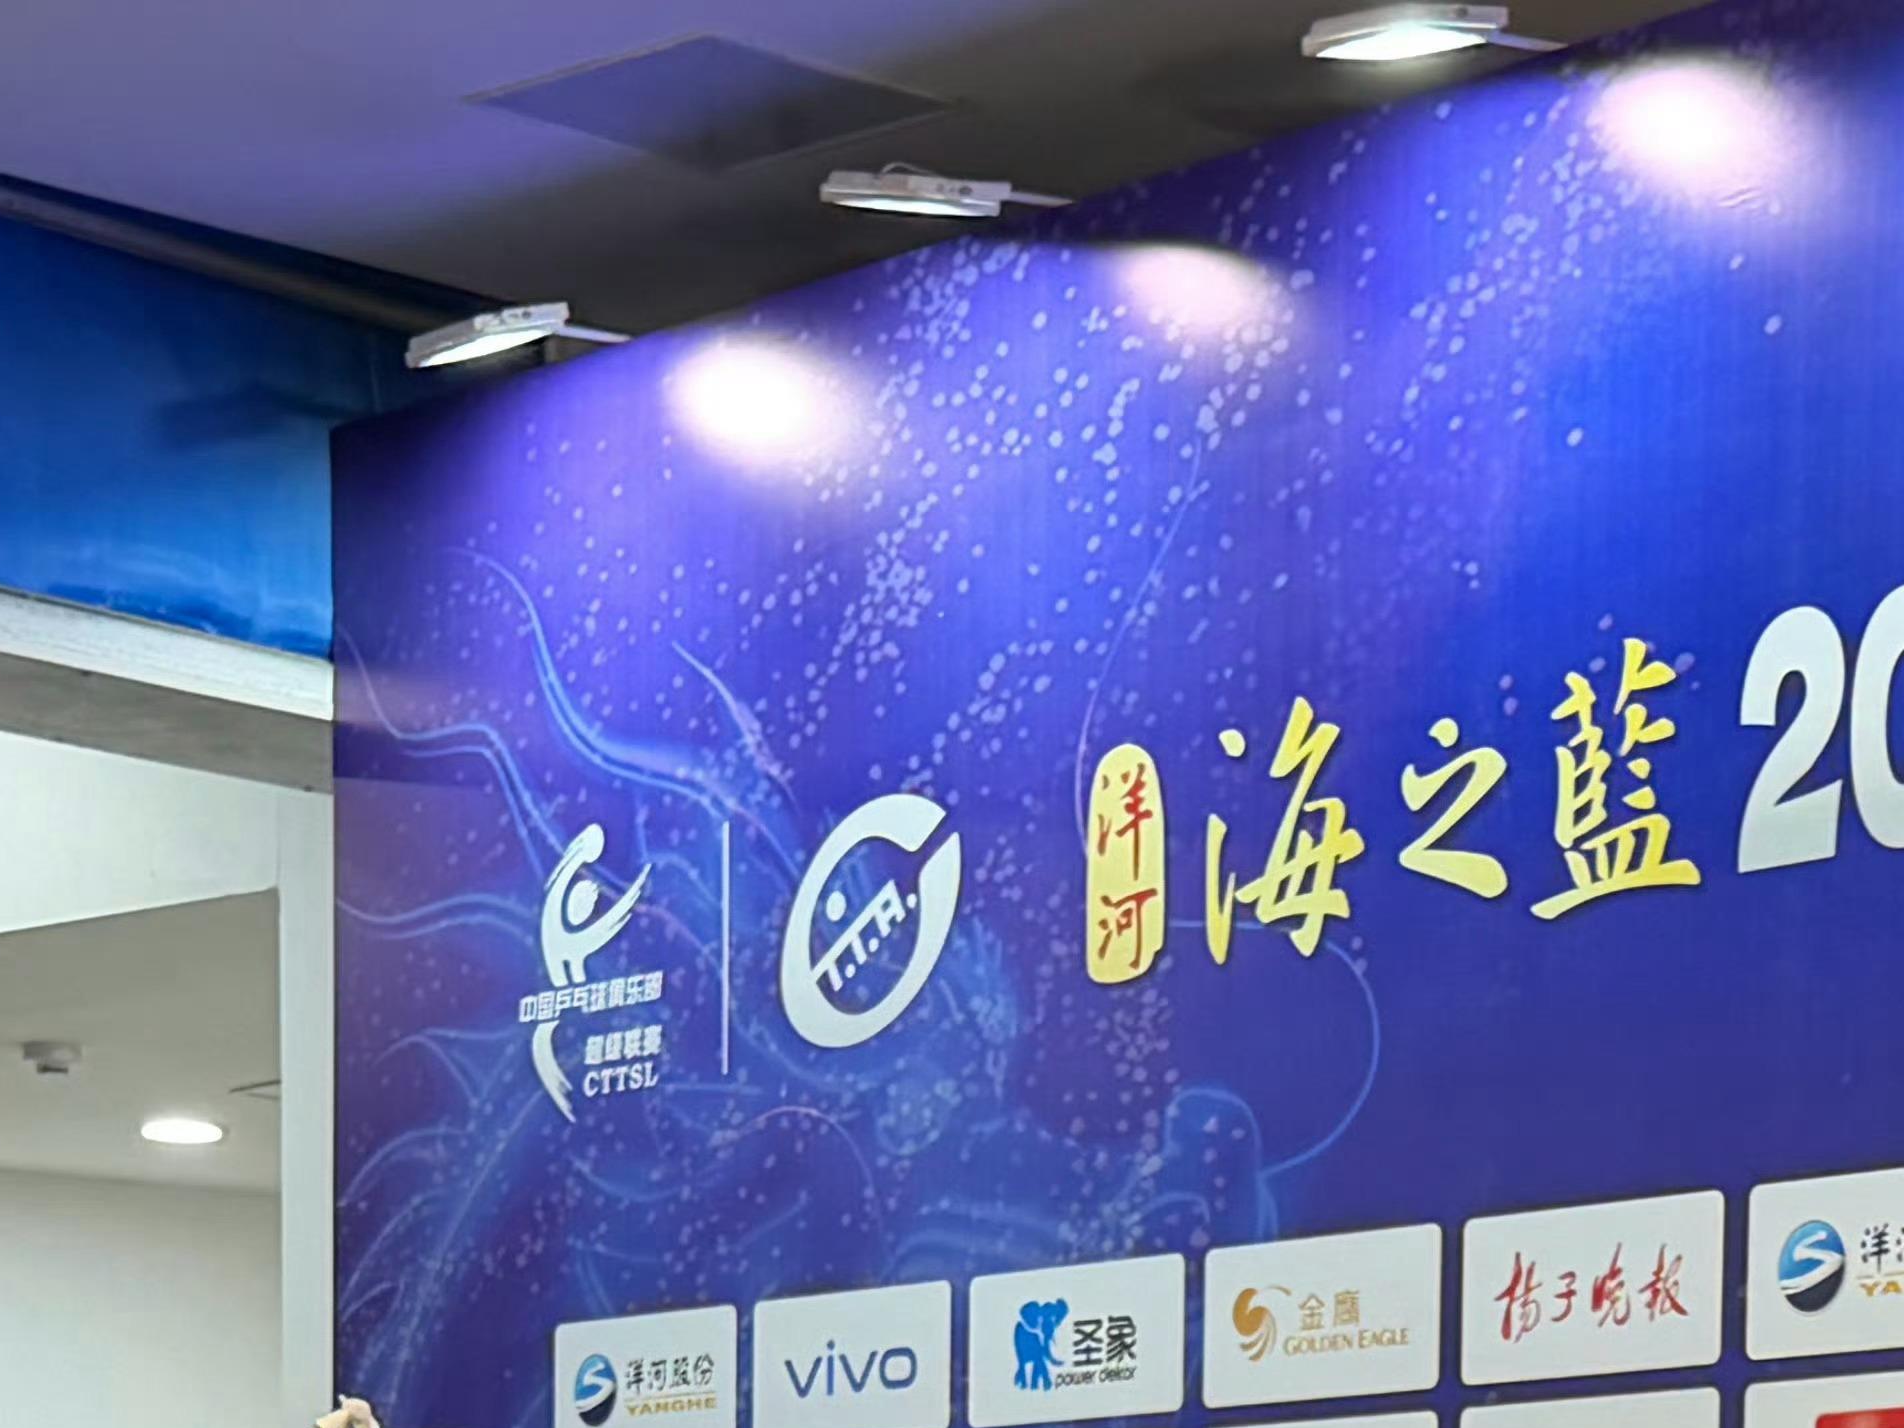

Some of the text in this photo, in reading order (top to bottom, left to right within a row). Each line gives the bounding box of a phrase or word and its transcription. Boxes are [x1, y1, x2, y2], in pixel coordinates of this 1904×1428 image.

[1096, 771, 1157, 969] 洋河
[583, 1063, 659, 1098] CTTSL
[1071, 1315, 1139, 1368] 圣象
[1283, 1325, 1410, 1357] GOLDEN EAGLE
[624, 1352, 714, 1391] 洋河股份
[784, 1339, 919, 1399] vivo
[625, 1393, 718, 1418] YANGHE
